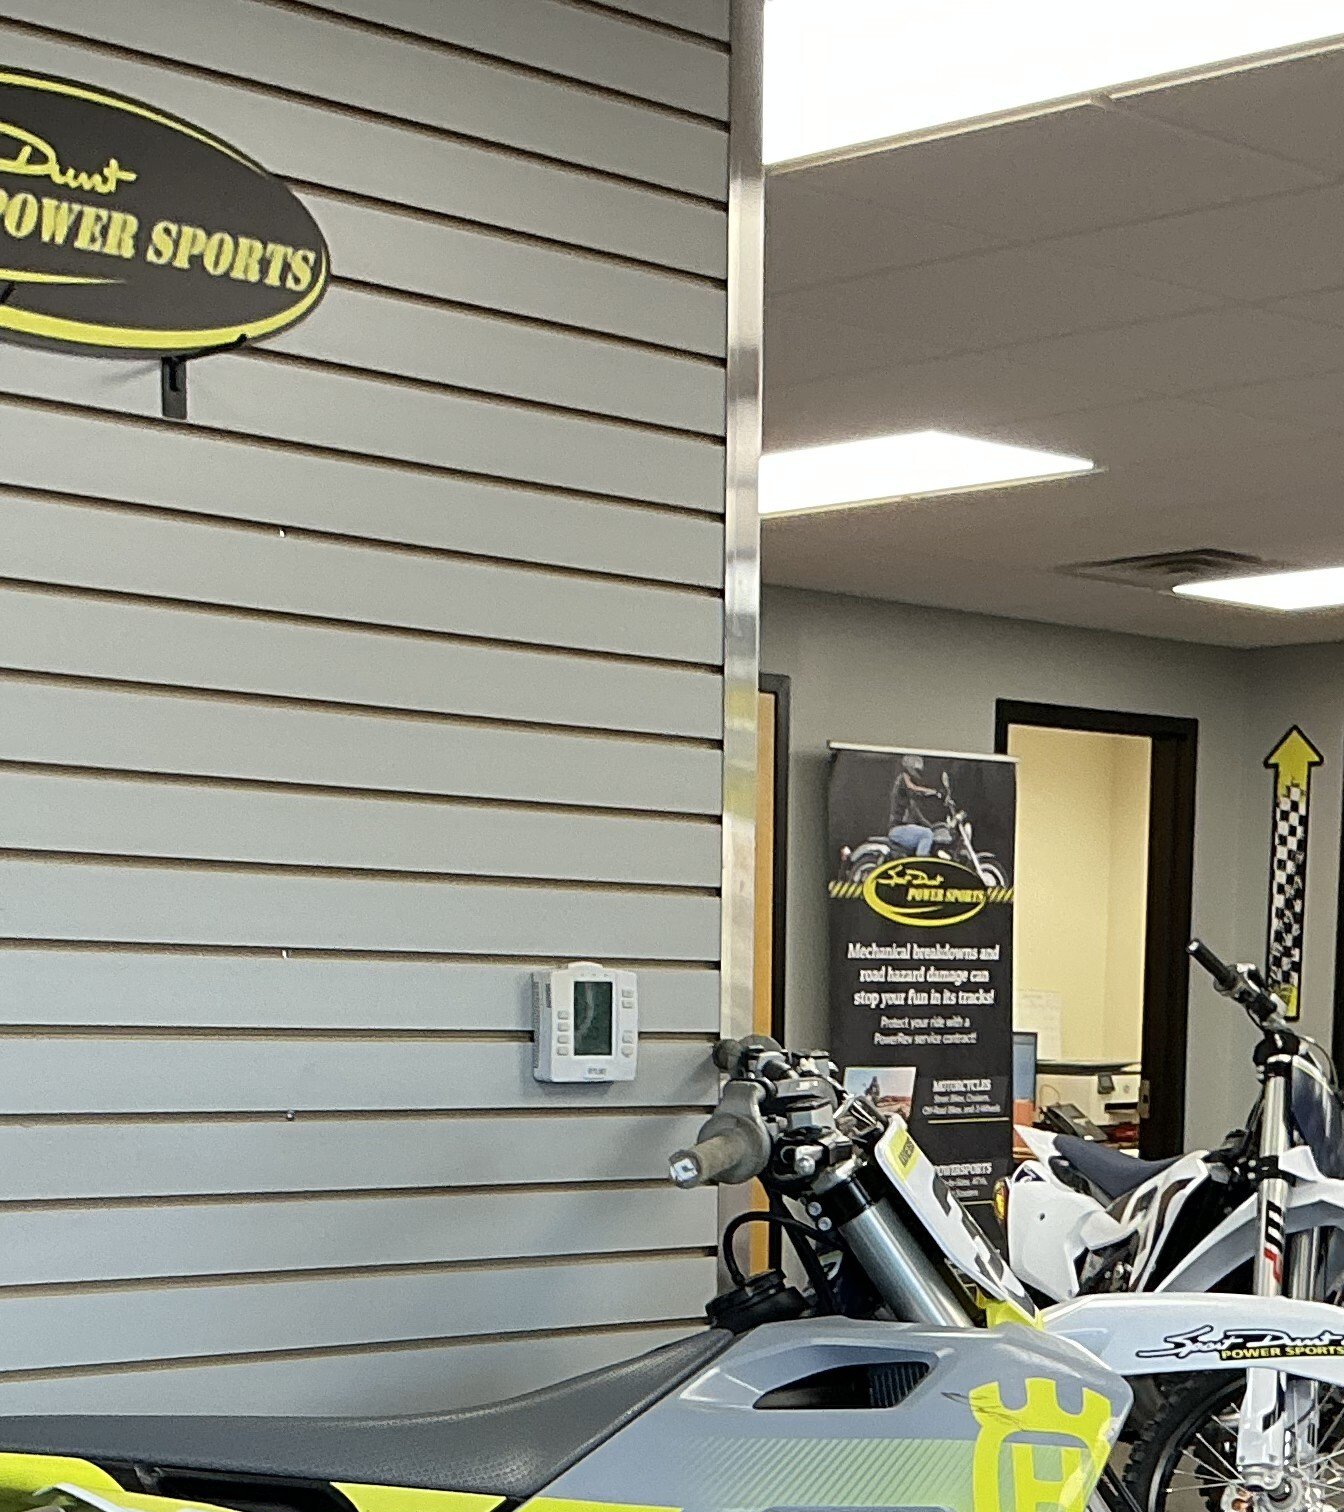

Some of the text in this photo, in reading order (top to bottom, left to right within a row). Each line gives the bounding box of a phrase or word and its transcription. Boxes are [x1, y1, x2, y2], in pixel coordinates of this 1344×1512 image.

[146, 220, 316, 292] SPORTS
[907, 887, 985, 903] POWER SPORTS
[847, 942, 1000, 960] Mechanical breakdowns and
[859, 965, 990, 986] road hazard damage can
[854, 990, 880, 1009] stop
[880, 991, 906, 1009] your
[908, 989, 929, 1005] fun
[930, 989, 941, 1005] in
[942, 989, 956, 1005] its
[1221, 1347, 1281, 1360] POWER
